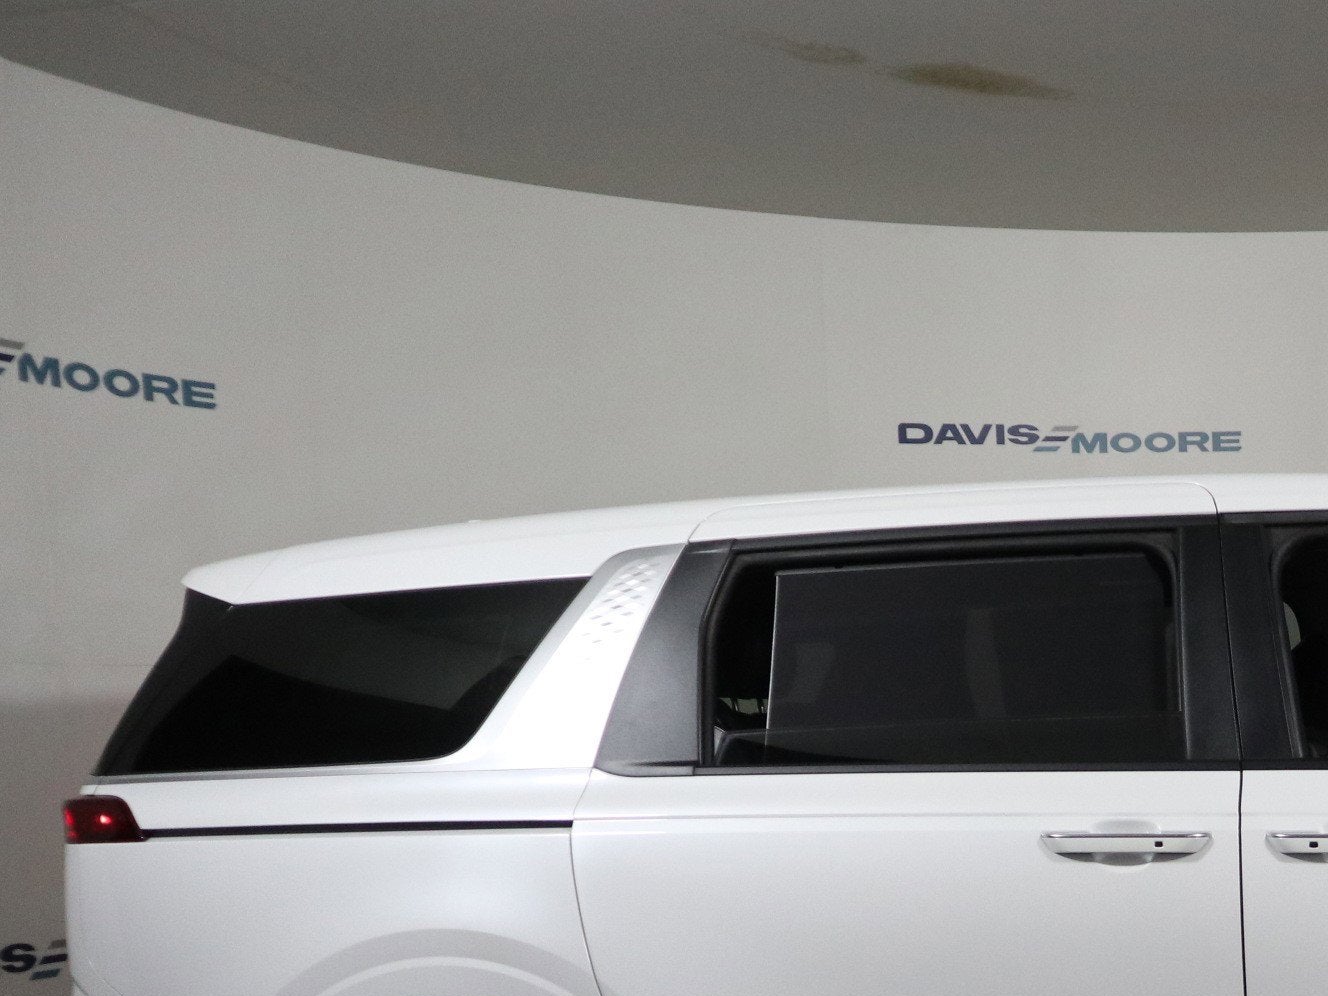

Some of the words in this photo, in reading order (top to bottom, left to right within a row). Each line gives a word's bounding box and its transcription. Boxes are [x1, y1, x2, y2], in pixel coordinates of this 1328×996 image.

[17, 353, 217, 409] MOORE
[898, 423, 1040, 446] DAVIS
[1071, 430, 1242, 454] MOORE
